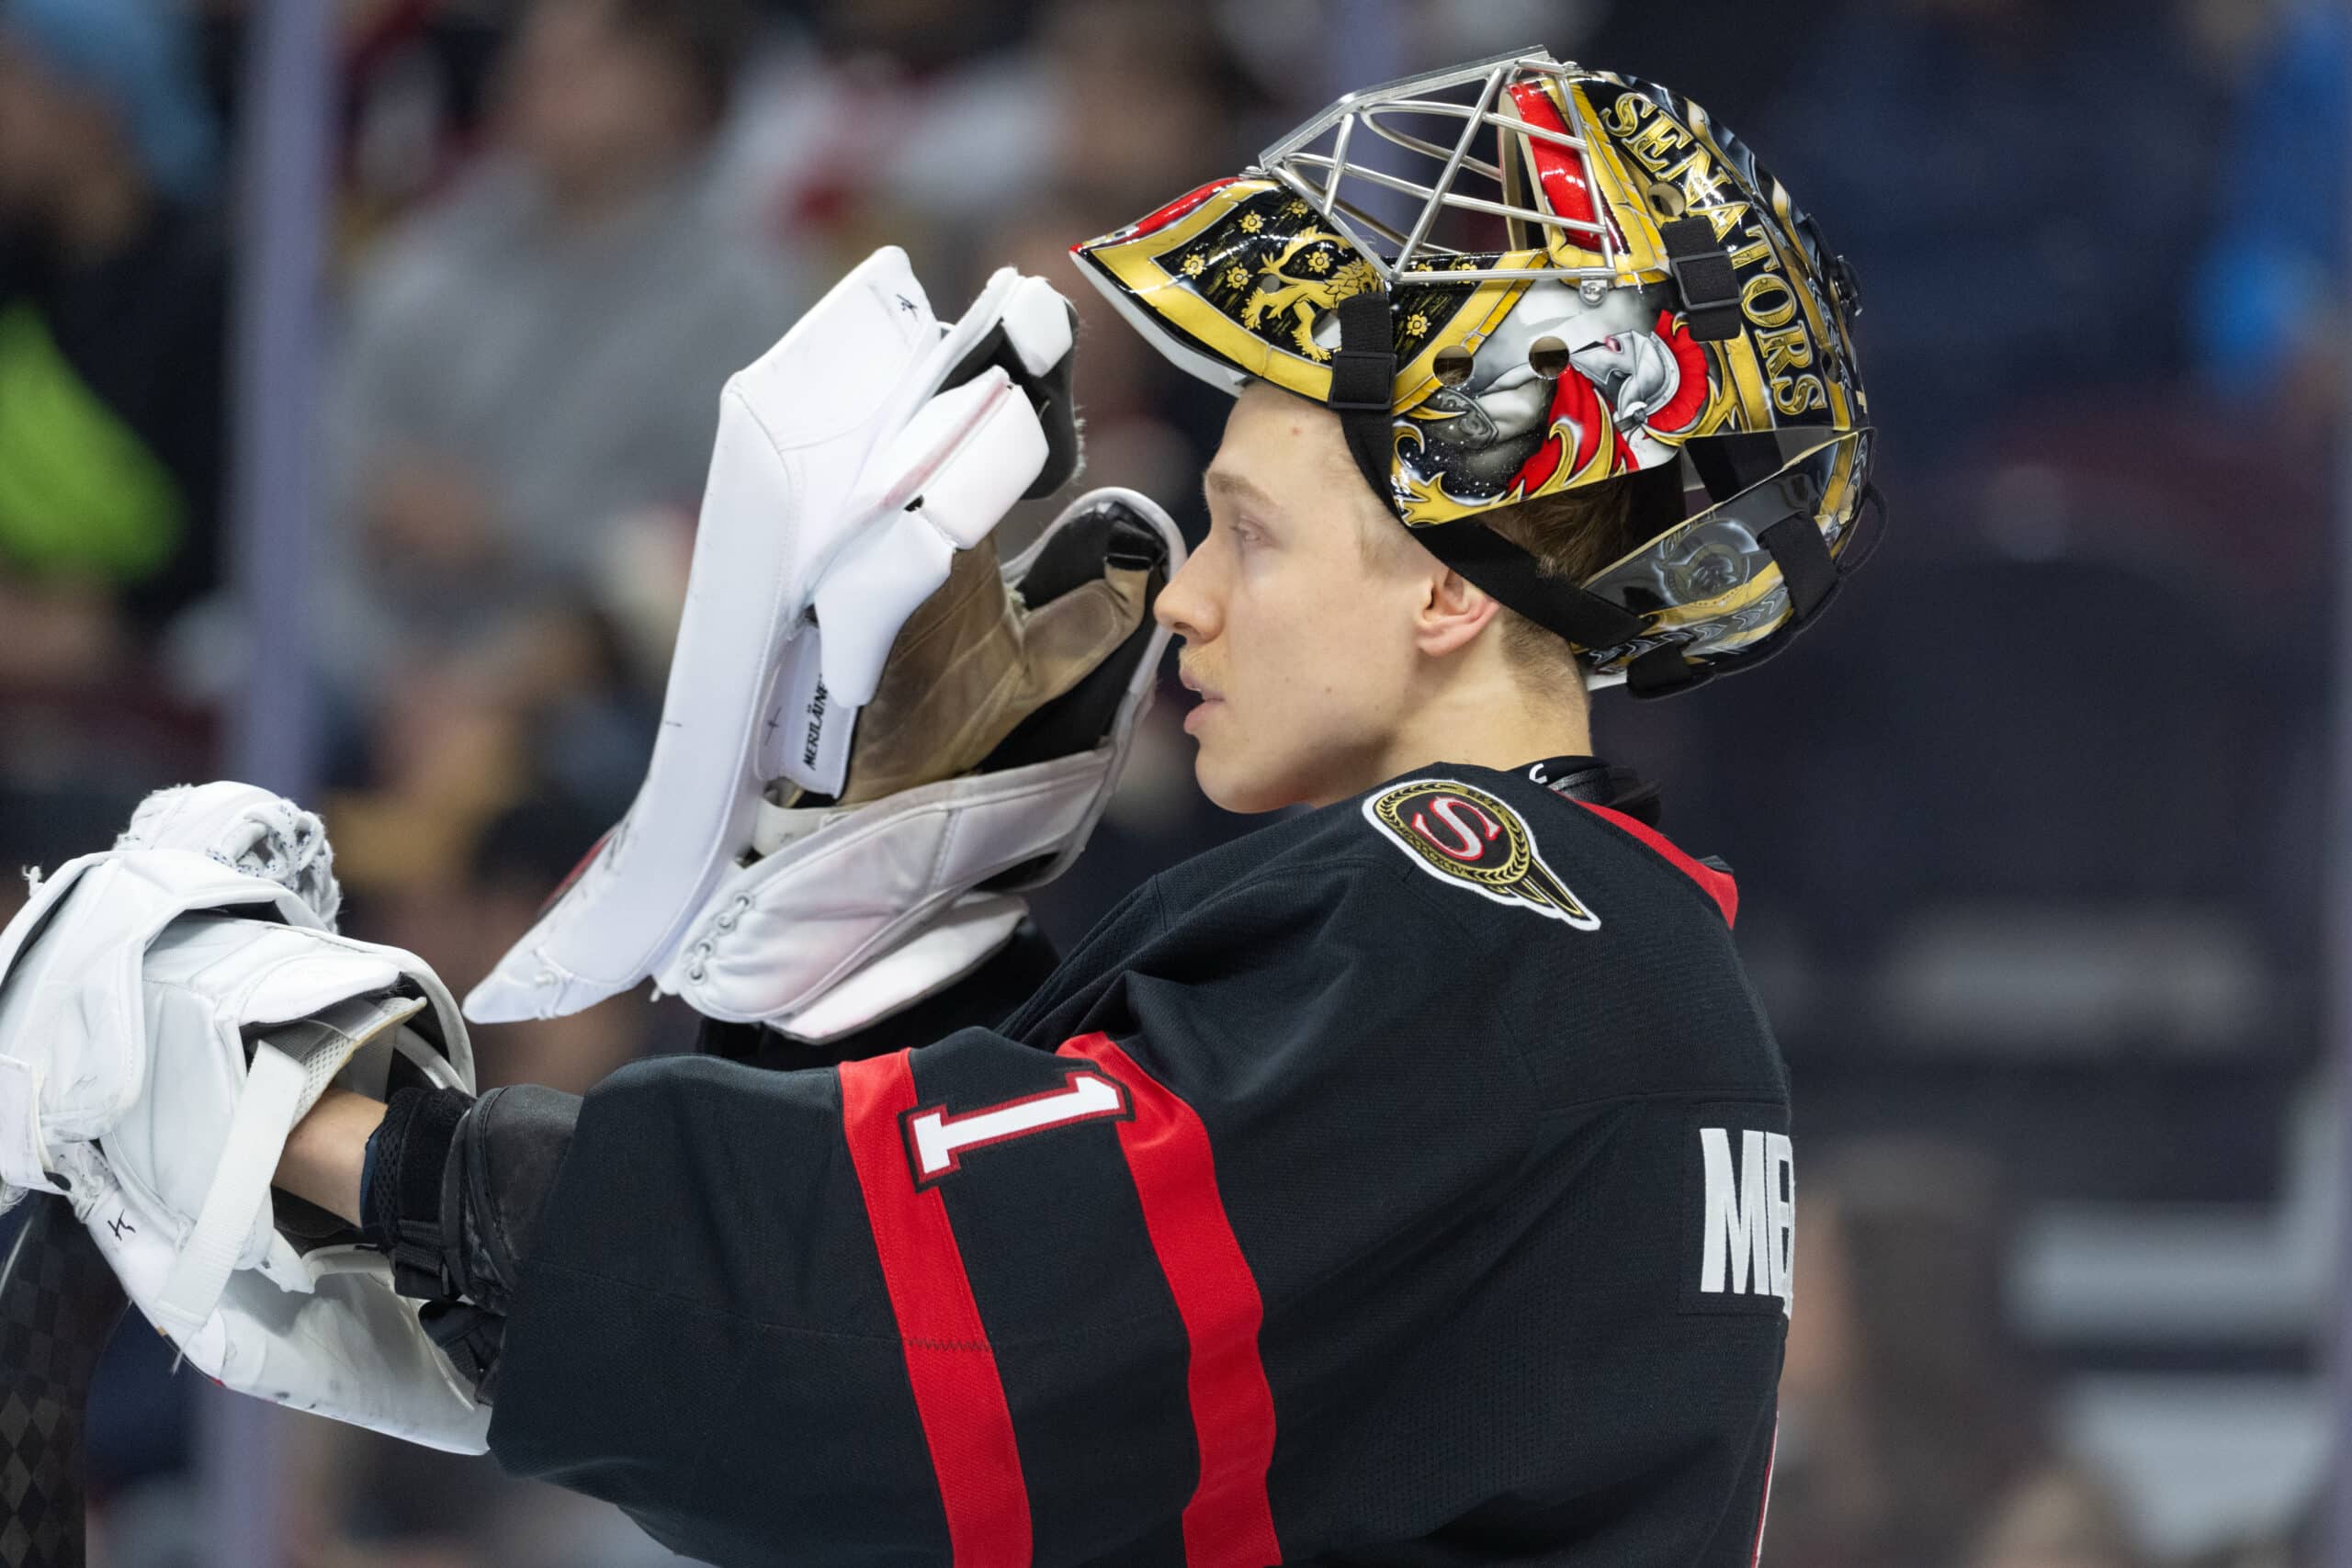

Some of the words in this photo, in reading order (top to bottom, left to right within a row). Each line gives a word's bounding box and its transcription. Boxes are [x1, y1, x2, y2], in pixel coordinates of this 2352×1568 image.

[1600, 92, 1827, 416] SENATORS
[1410, 795, 1503, 862] S
[906, 1070, 1128, 1184] 1
[1699, 1127, 1796, 1320] ME
